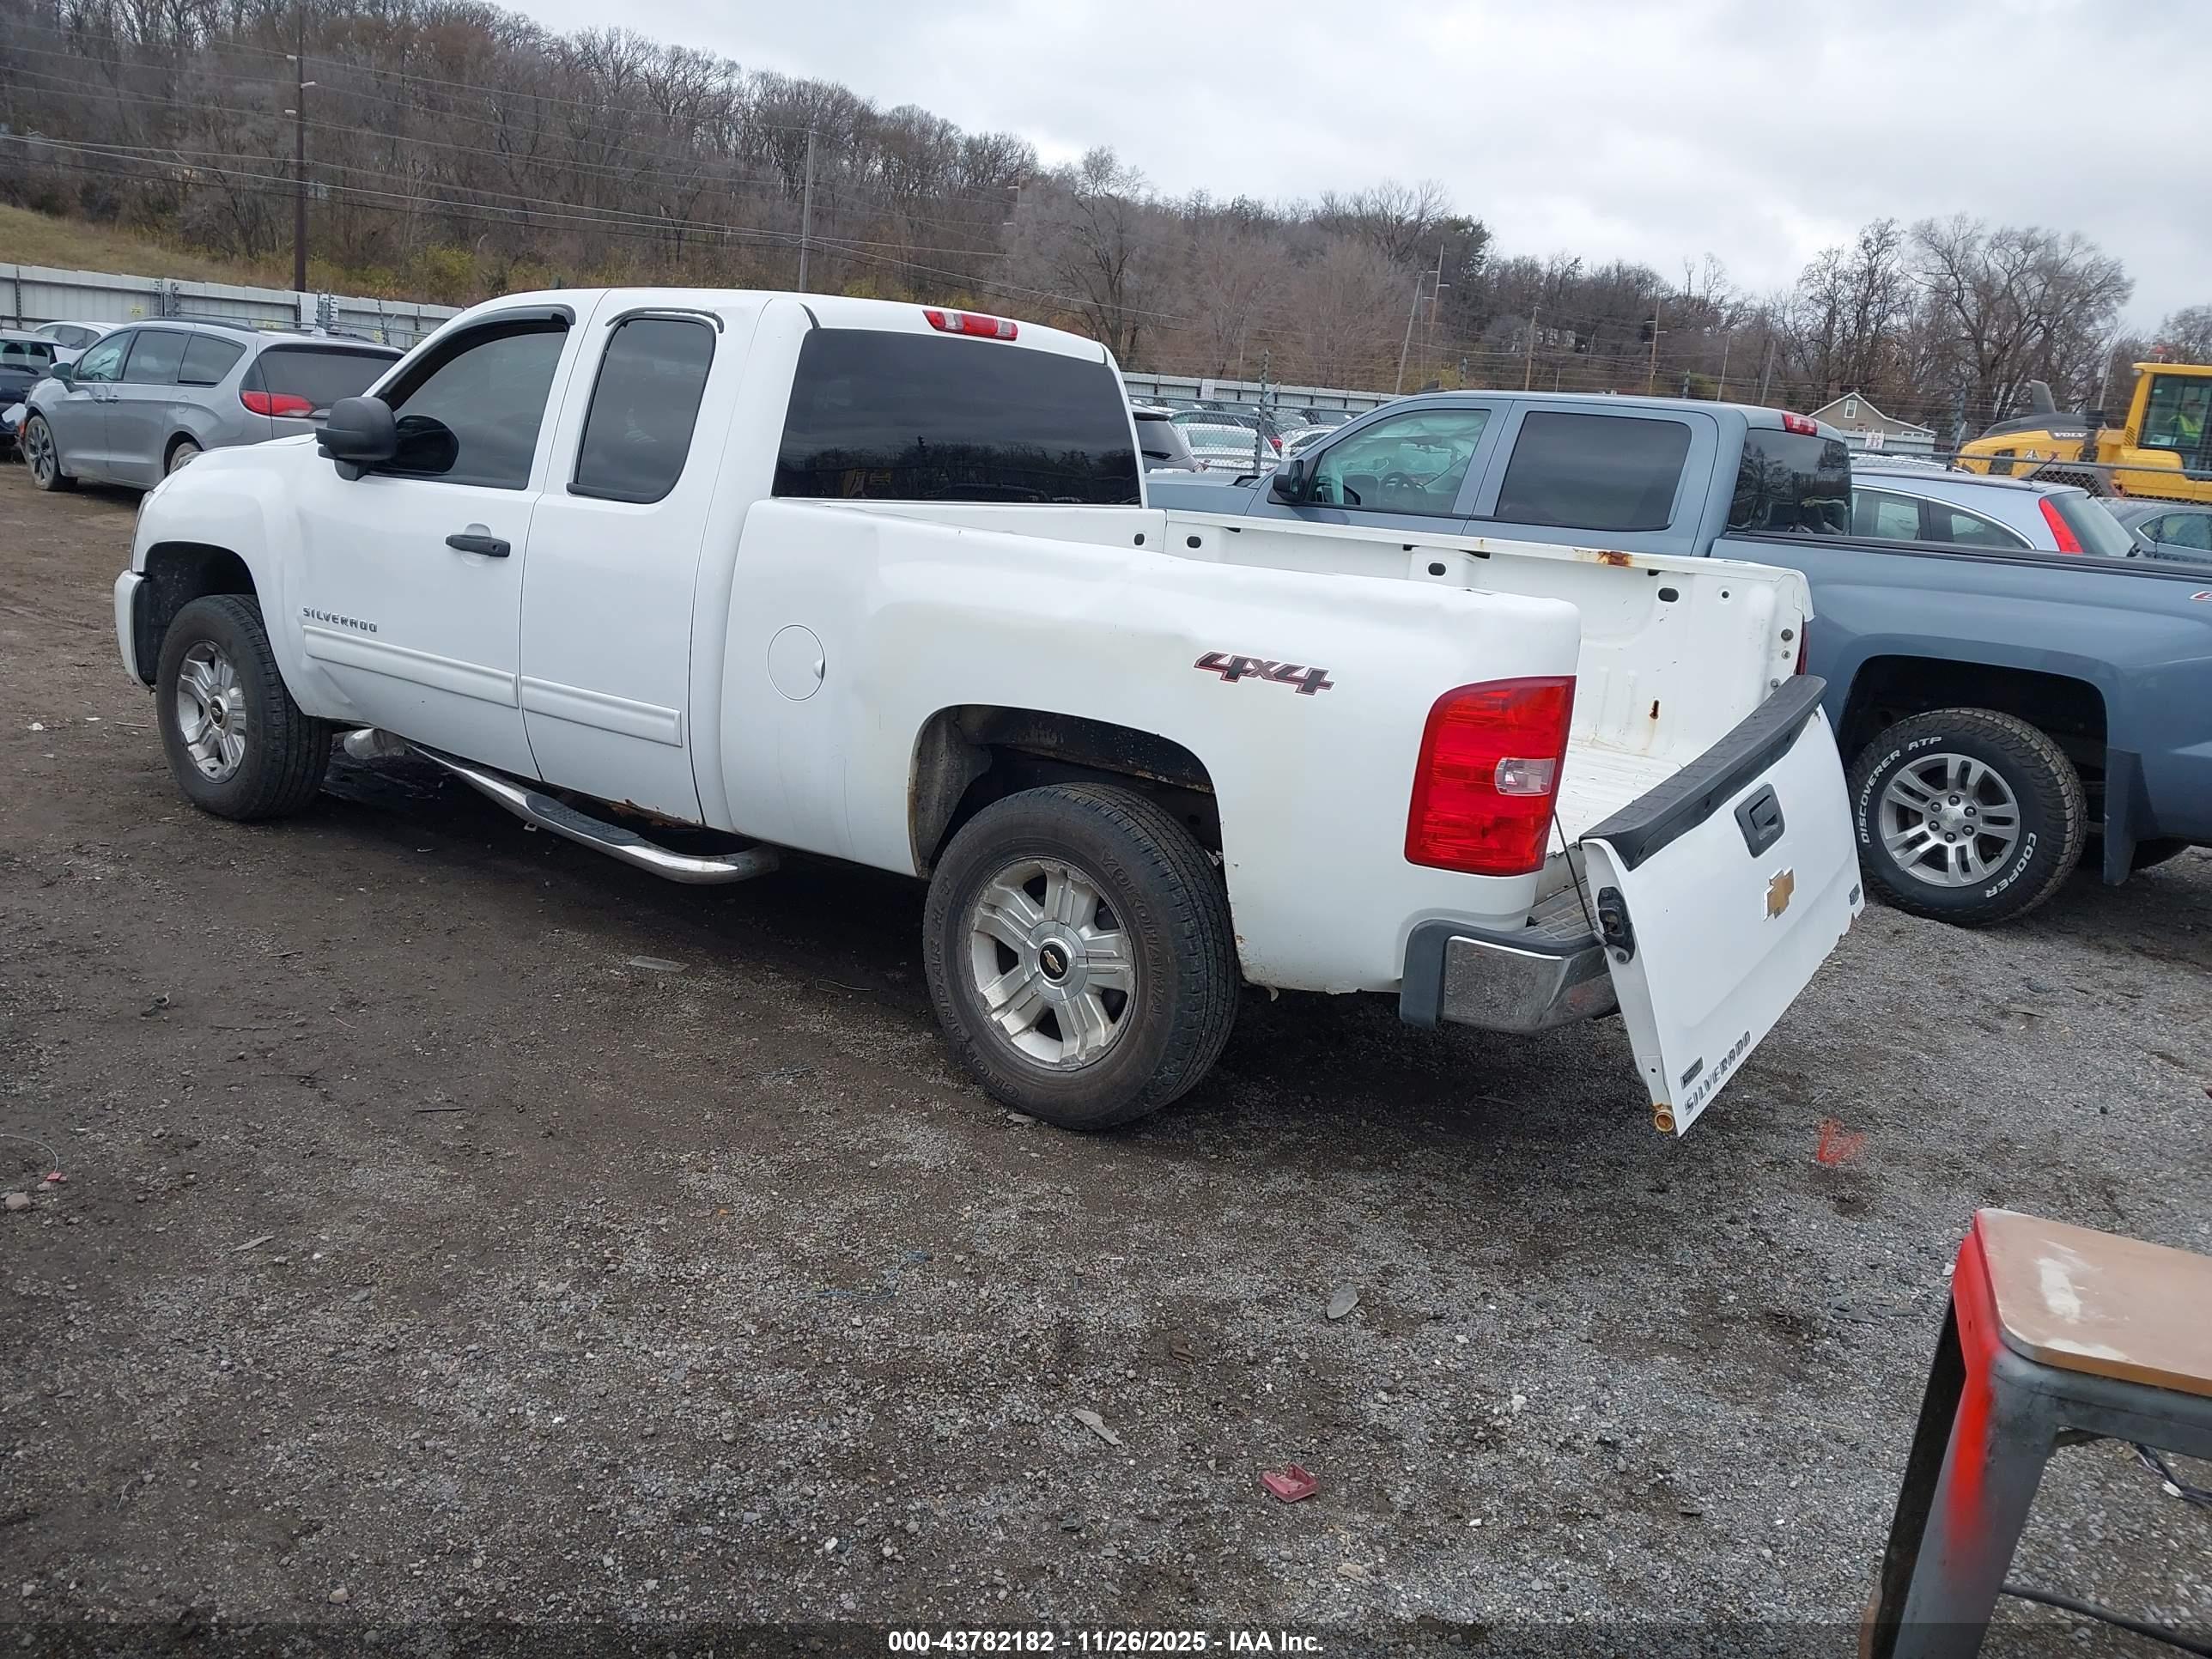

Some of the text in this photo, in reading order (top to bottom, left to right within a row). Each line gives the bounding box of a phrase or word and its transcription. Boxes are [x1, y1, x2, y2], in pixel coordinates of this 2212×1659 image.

[302, 605, 378, 633] SILVERADO
[1858, 736, 1942, 844] DISCOVERER ATP
[1984, 830, 2038, 899] COOPER
[1100, 848, 1164, 1017] YOKOHAMA
[1684, 1030, 1752, 1115] SILVERADO
